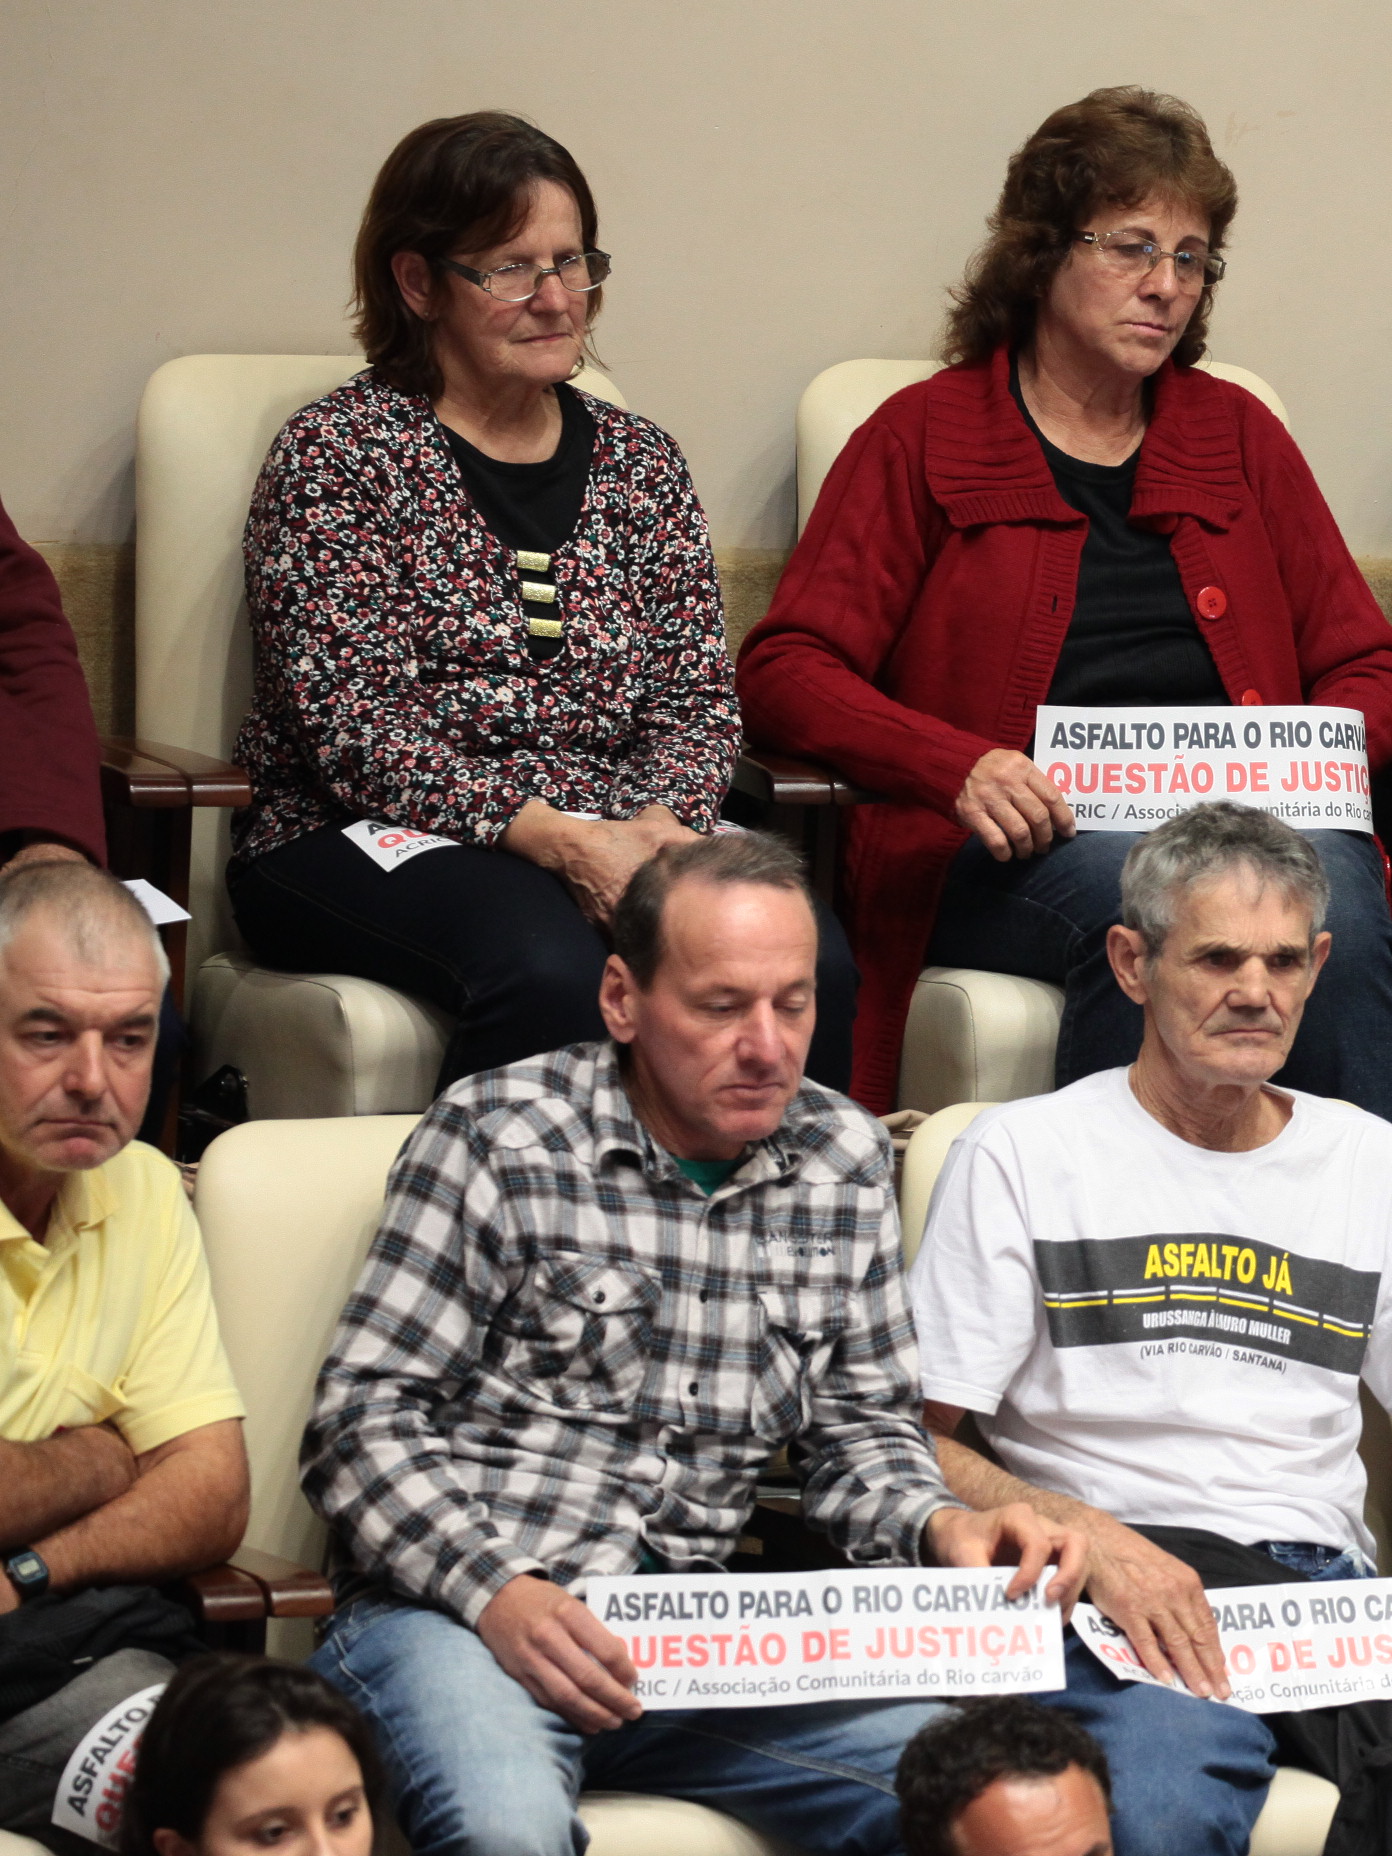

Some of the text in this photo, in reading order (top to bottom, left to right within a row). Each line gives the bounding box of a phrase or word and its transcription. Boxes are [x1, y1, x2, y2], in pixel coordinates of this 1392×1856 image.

[1050, 722, 1165, 750] ASFALTO
[1173, 722, 1237, 750] PARA
[1243, 721, 1262, 749] O
[1269, 720, 1312, 749] RIO
[1046, 754, 1372, 805] QUESTÃO DE JUSTIÇ
[1067, 803, 1107, 819] RIC
[1111, 803, 1121, 820] /
[1124, 803, 1188, 820] Associ
[1256, 801, 1321, 818] nitária
[1324, 801, 1342, 817] do
[1345, 802, 1362, 820] Rio
[1144, 1242, 1293, 1296] ASFALTO JÁ
[1142, 1311, 1207, 1329] URUSSANGA
[1248, 1320, 1292, 1345] MULLER
[1140, 1345, 1164, 1360] (VIA
[1167, 1342, 1186, 1354] RIO
[1189, 1342, 1222, 1359] CARVÃO
[1232, 1350, 1287, 1374] SANTANA)
[604, 1590, 729, 1622] ASFALTO
[738, 1589, 813, 1620] PARA
[822, 1585, 843, 1615] O
[852, 1584, 903, 1614] RIO
[1280, 1599, 1302, 1627] O
[1308, 1596, 1356, 1625] RIO
[614, 1625, 787, 1669] UESTÃO
[801, 1628, 852, 1663] DE
[865, 1624, 1046, 1667] JUSTIÇA!
[1267, 1639, 1317, 1673] DE
[634, 1679, 667, 1697] RIC
[686, 1677, 791, 1697] Associação
[796, 1669, 911, 1692] Comunitária
[916, 1668, 940, 1687] do
[946, 1668, 975, 1686] Rio
[982, 1666, 1044, 1684] carvão
[66, 1706, 148, 1817] ASFALTO
